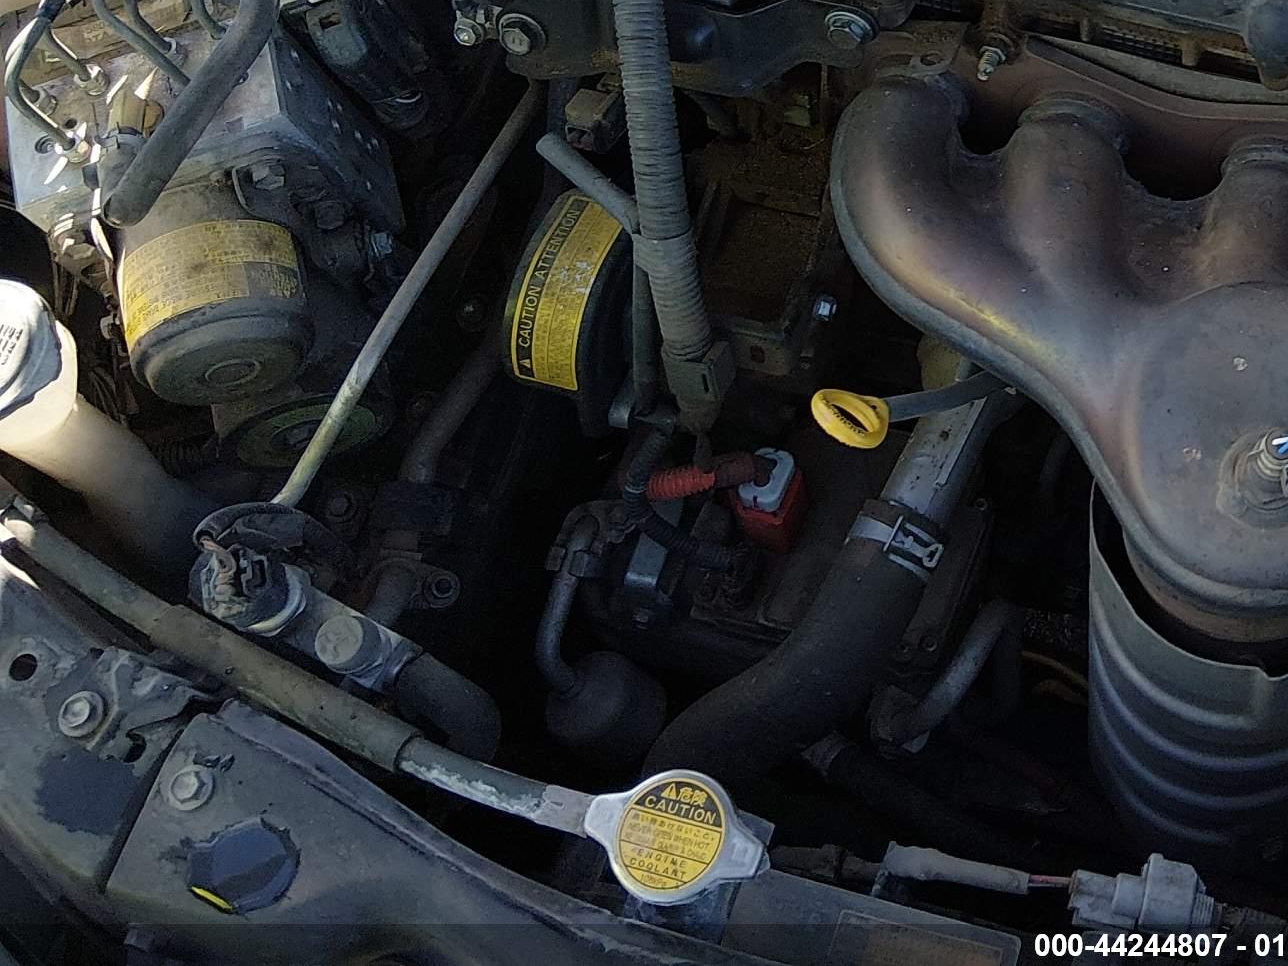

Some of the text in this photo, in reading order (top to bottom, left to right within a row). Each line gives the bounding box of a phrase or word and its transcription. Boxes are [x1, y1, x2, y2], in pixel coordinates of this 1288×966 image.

[518, 209, 580, 348] CAUTION ATTENTION
[644, 795, 717, 825] CAUTION
[630, 857, 688, 880] COOLANT
[635, 848, 688, 868] ENGINE
